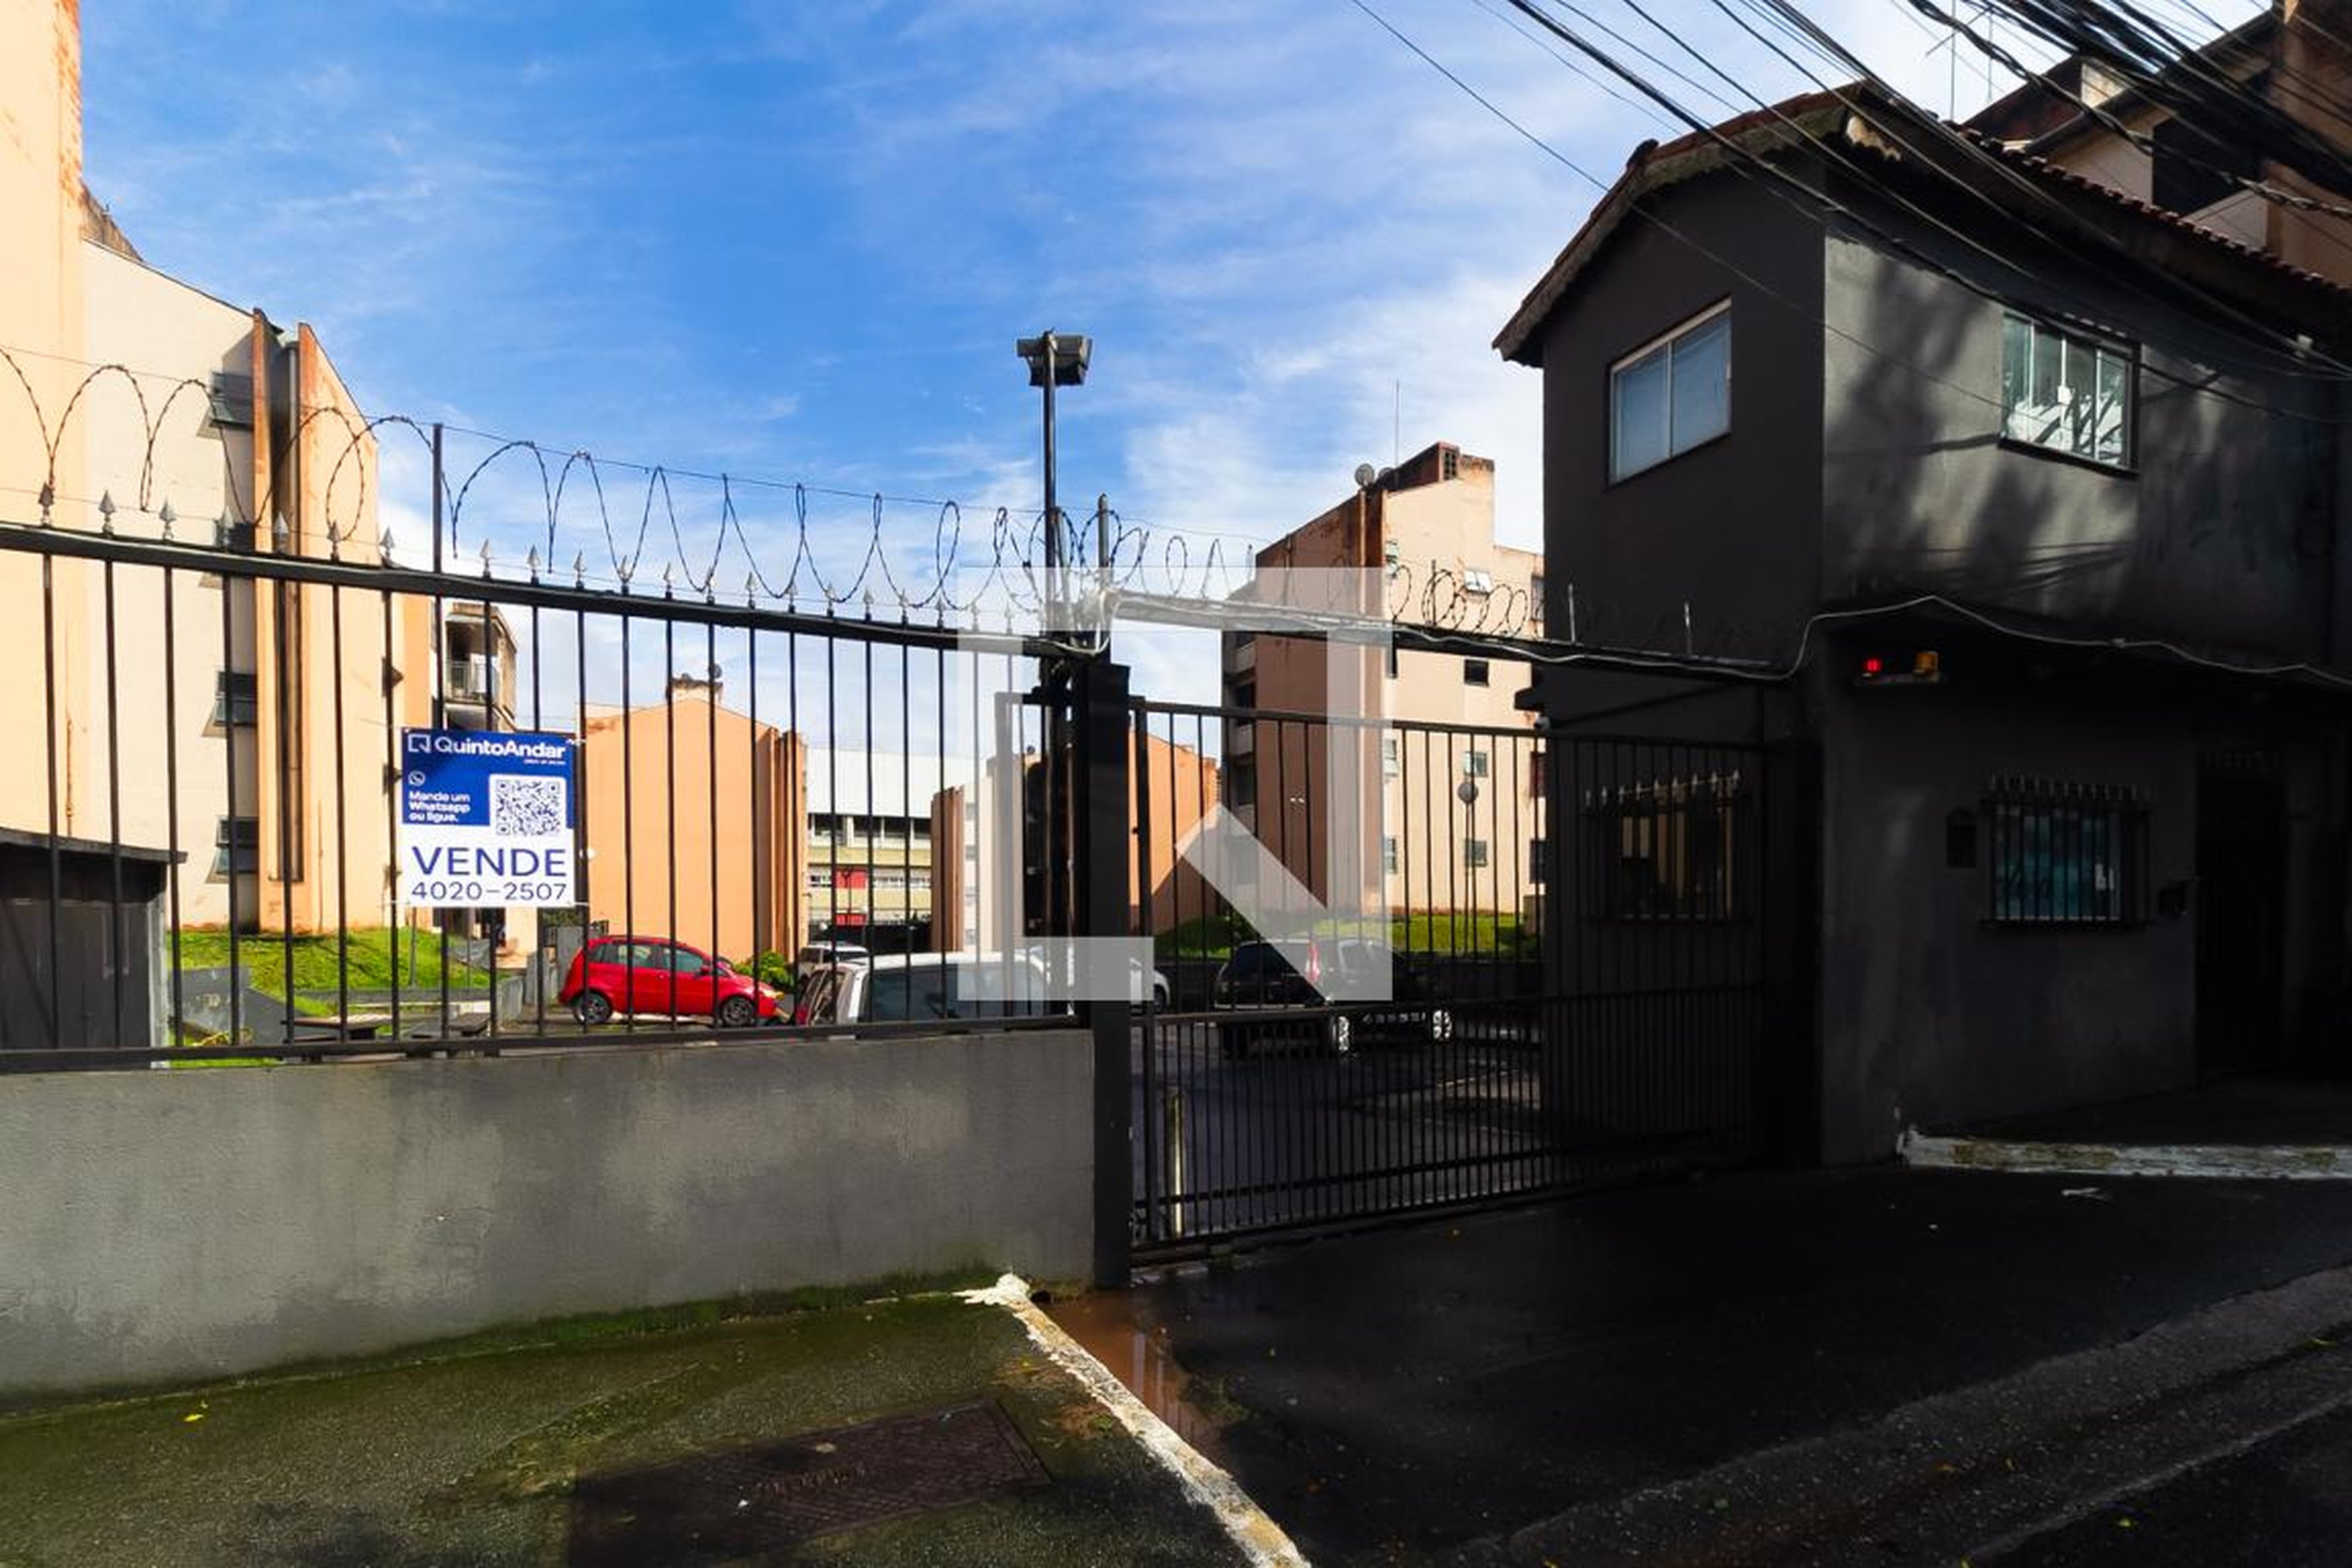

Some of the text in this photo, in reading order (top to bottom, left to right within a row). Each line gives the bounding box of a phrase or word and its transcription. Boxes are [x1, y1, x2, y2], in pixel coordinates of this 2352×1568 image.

[434, 737, 566, 758] QuintoAndar
[451, 794, 470, 802] um
[409, 812, 424, 821] ou
[412, 846, 567, 876] VENDE
[412, 881, 567, 900] 4020-2507
